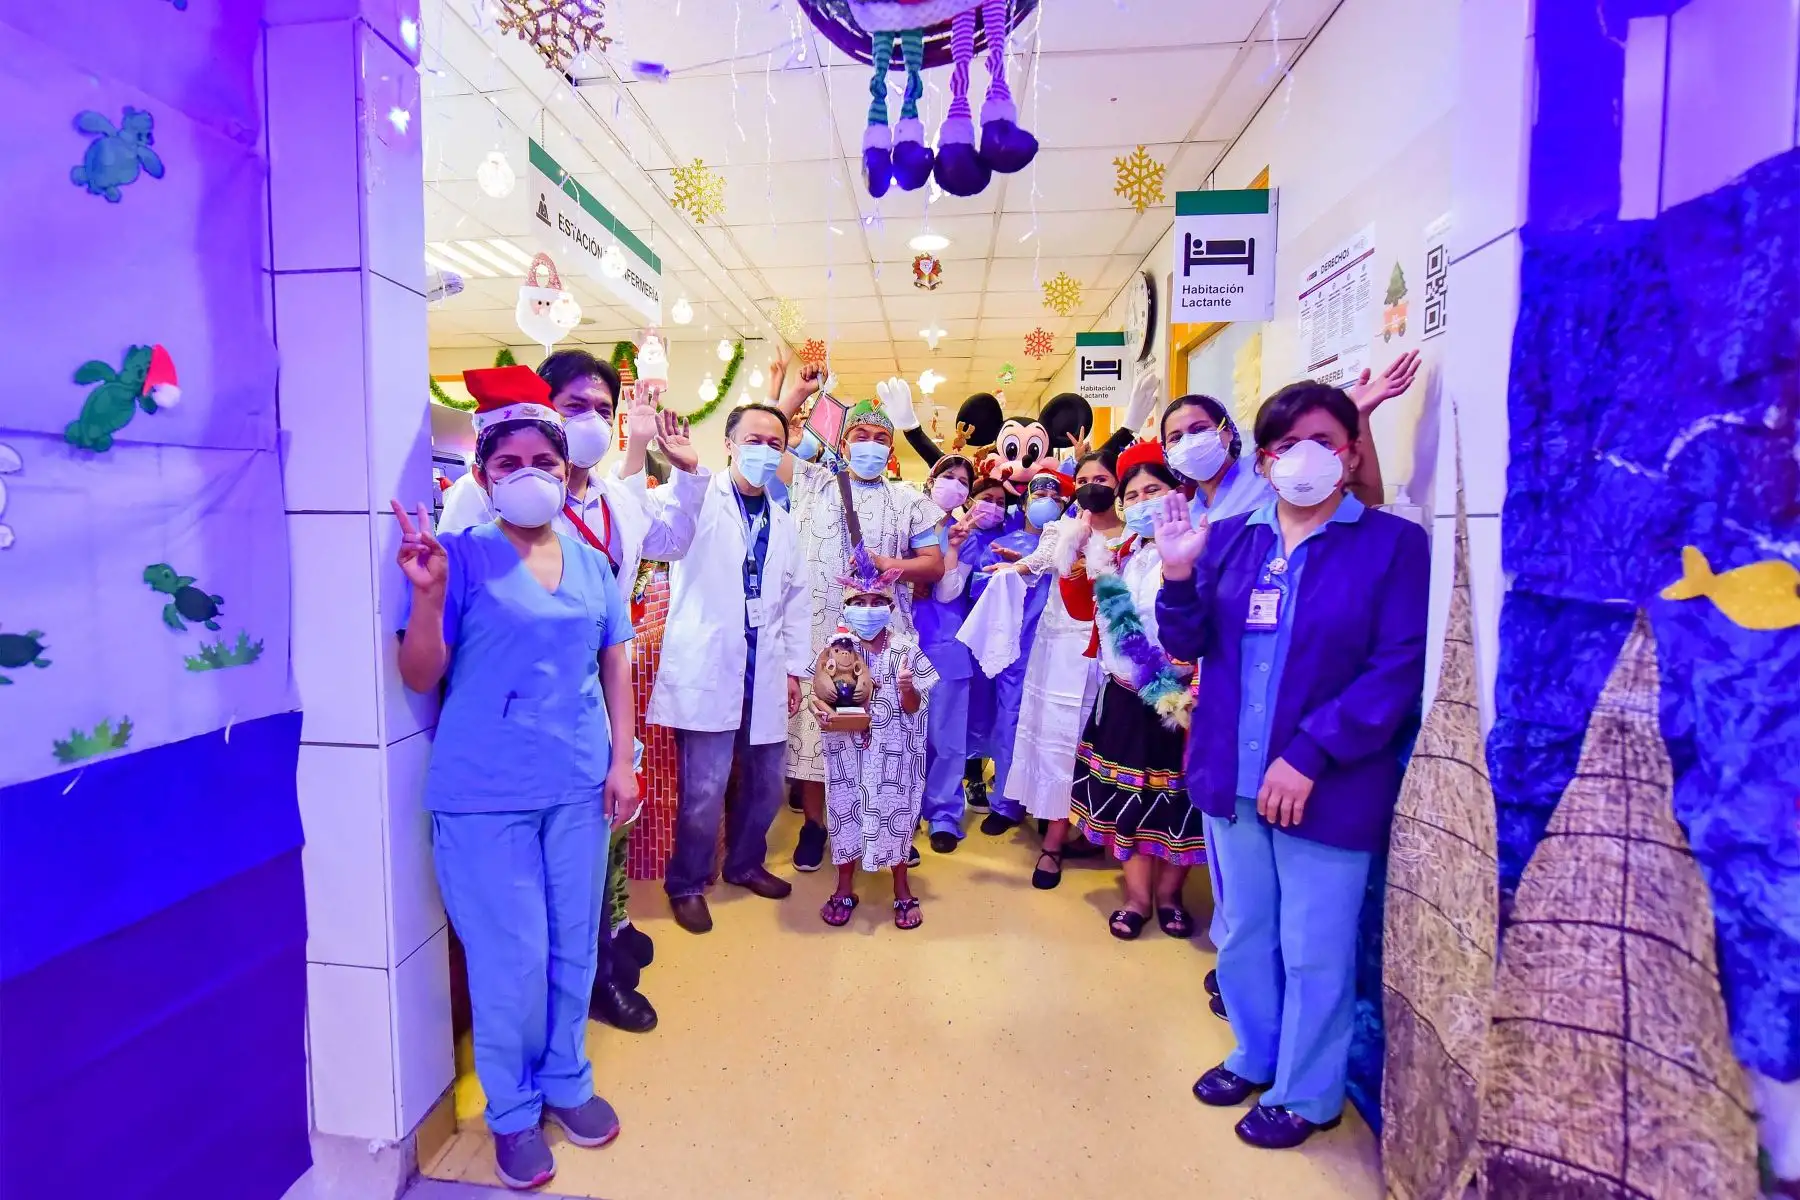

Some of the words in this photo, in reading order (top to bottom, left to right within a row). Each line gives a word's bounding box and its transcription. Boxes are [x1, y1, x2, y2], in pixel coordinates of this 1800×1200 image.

[558, 213, 603, 260] ESTACIÓN
[1320, 248, 1350, 274] DERECHOS
[1182, 284, 1244, 295] Habitación
[1181, 297, 1232, 308] Lactante
